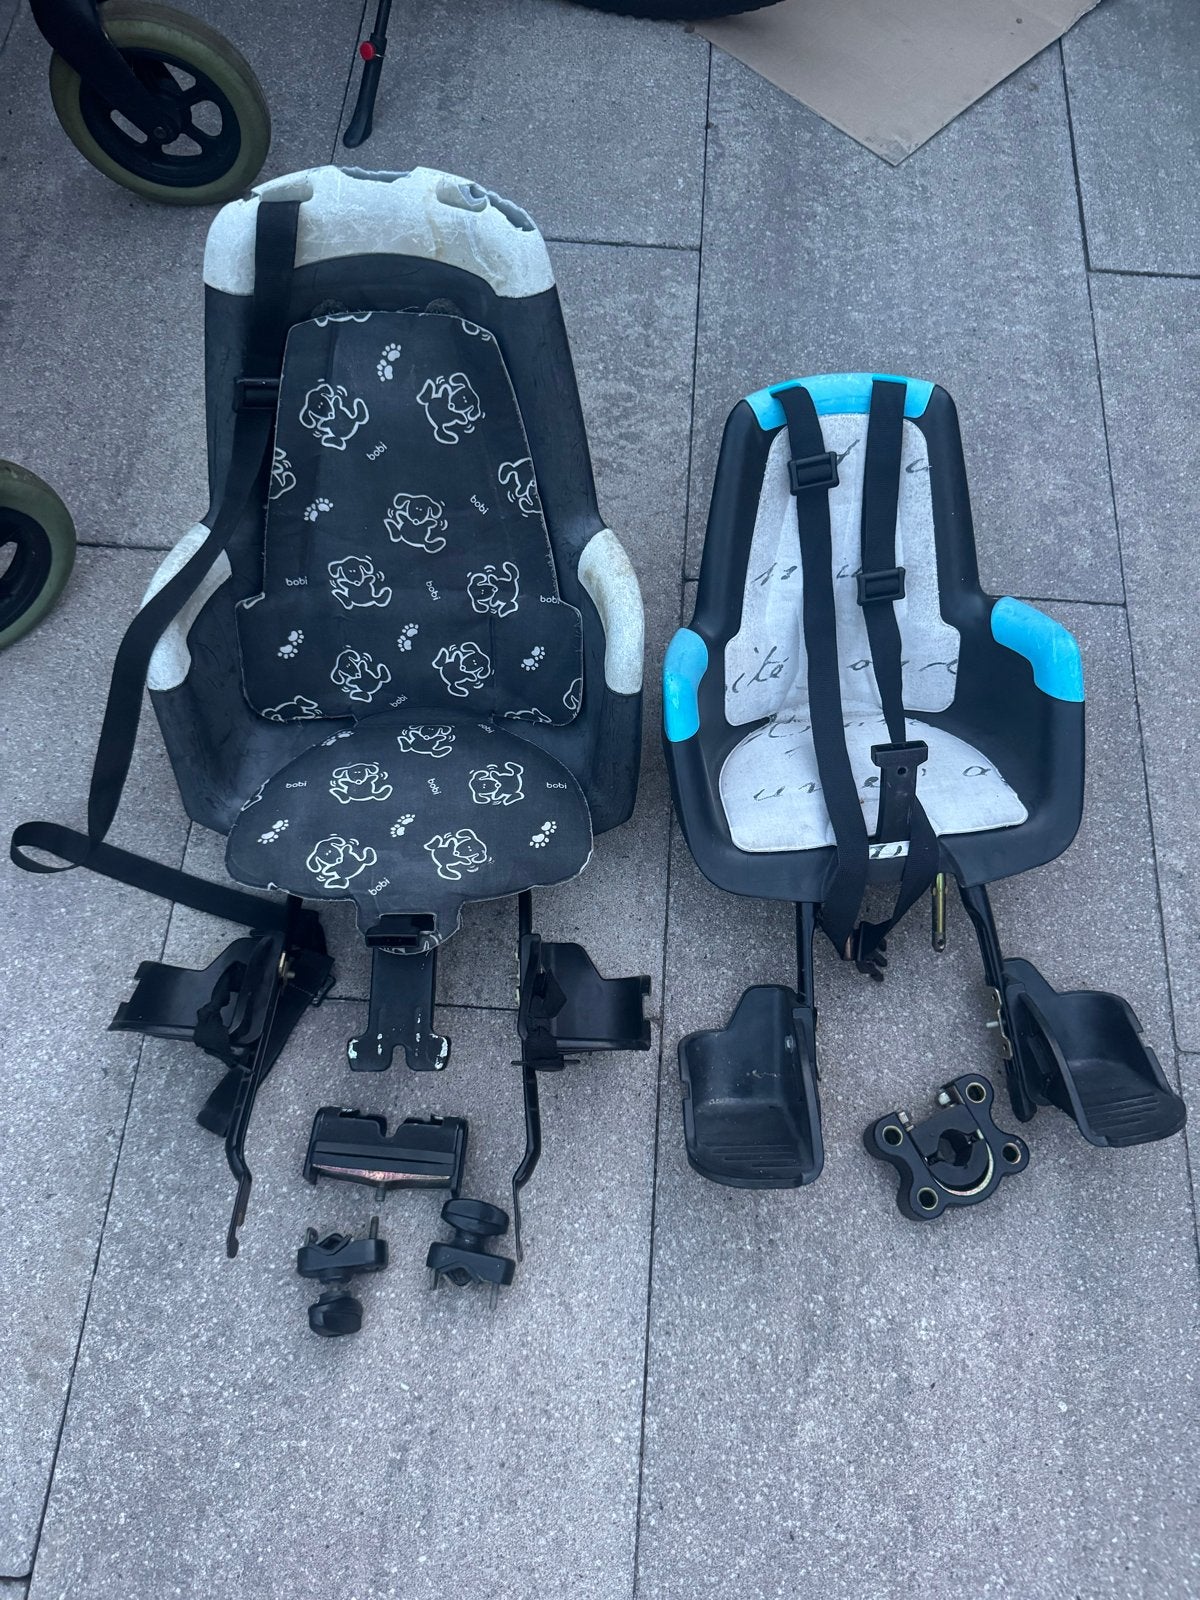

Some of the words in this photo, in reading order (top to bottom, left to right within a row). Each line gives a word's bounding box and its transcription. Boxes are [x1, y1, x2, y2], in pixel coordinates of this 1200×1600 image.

[366, 441, 388, 461] bobi
[470, 494, 489, 515] bobi
[285, 576, 308, 586] bobi
[426, 580, 441, 600] bobi
[389, 694, 408, 708] bobi
[286, 780, 307, 789] bobi
[427, 777, 442, 795] bobi
[546, 781, 567, 790] bobi
[368, 877, 391, 896] bobi
